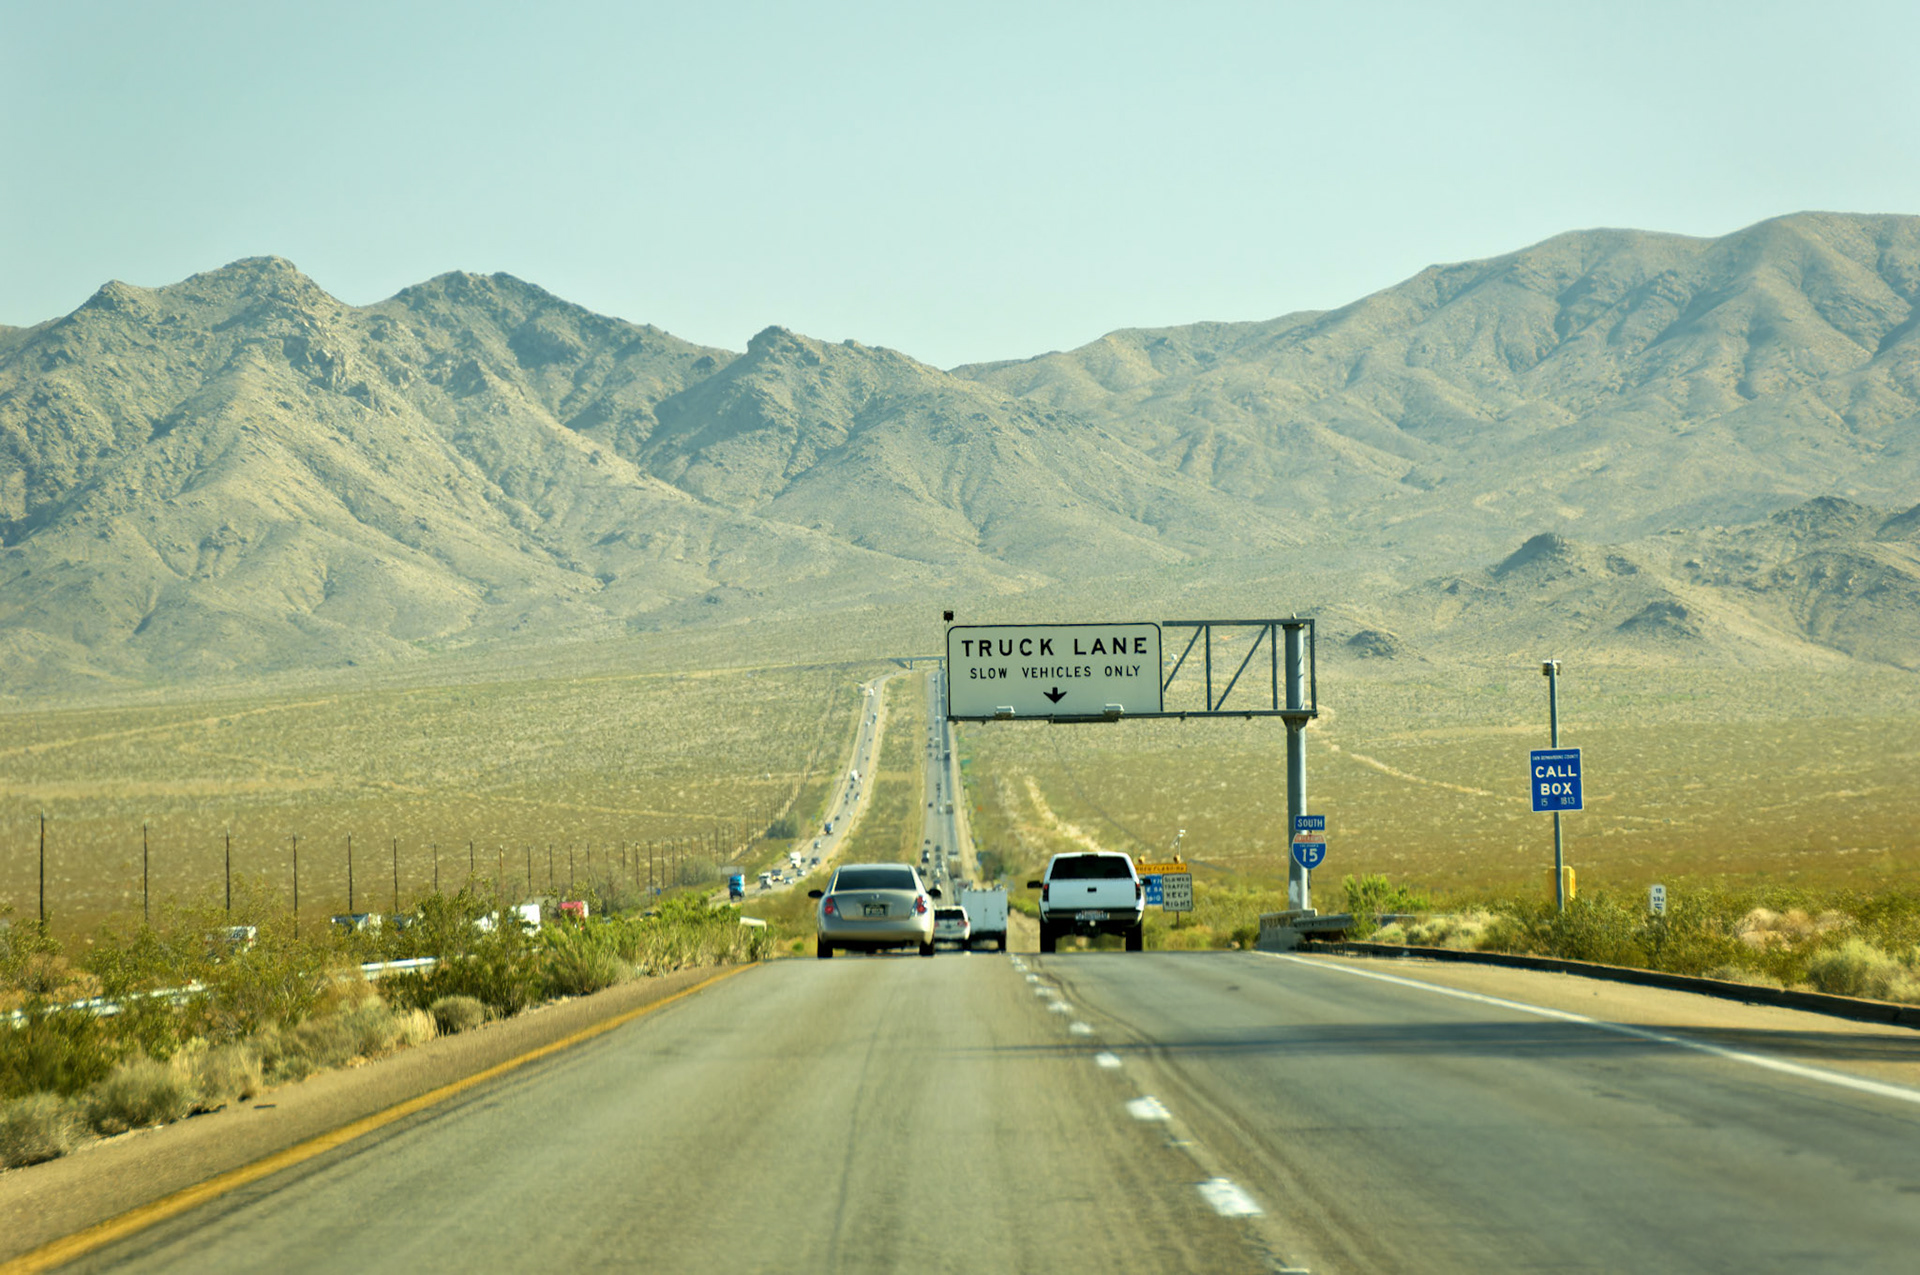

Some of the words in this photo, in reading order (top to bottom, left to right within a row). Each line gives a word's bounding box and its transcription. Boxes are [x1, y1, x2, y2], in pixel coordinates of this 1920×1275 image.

[961, 638, 1054, 657] TRUCK
[1074, 637, 1147, 655] LANE
[970, 667, 1008, 679] SLOW
[1022, 665, 1092, 678] VEHICLES
[1104, 665, 1141, 677] ONLY
[1535, 764, 1578, 778] CALL
[1540, 782, 1572, 796] BOX
[1297, 818, 1323, 828] SOUTH
[1302, 848, 1318, 862] 15
